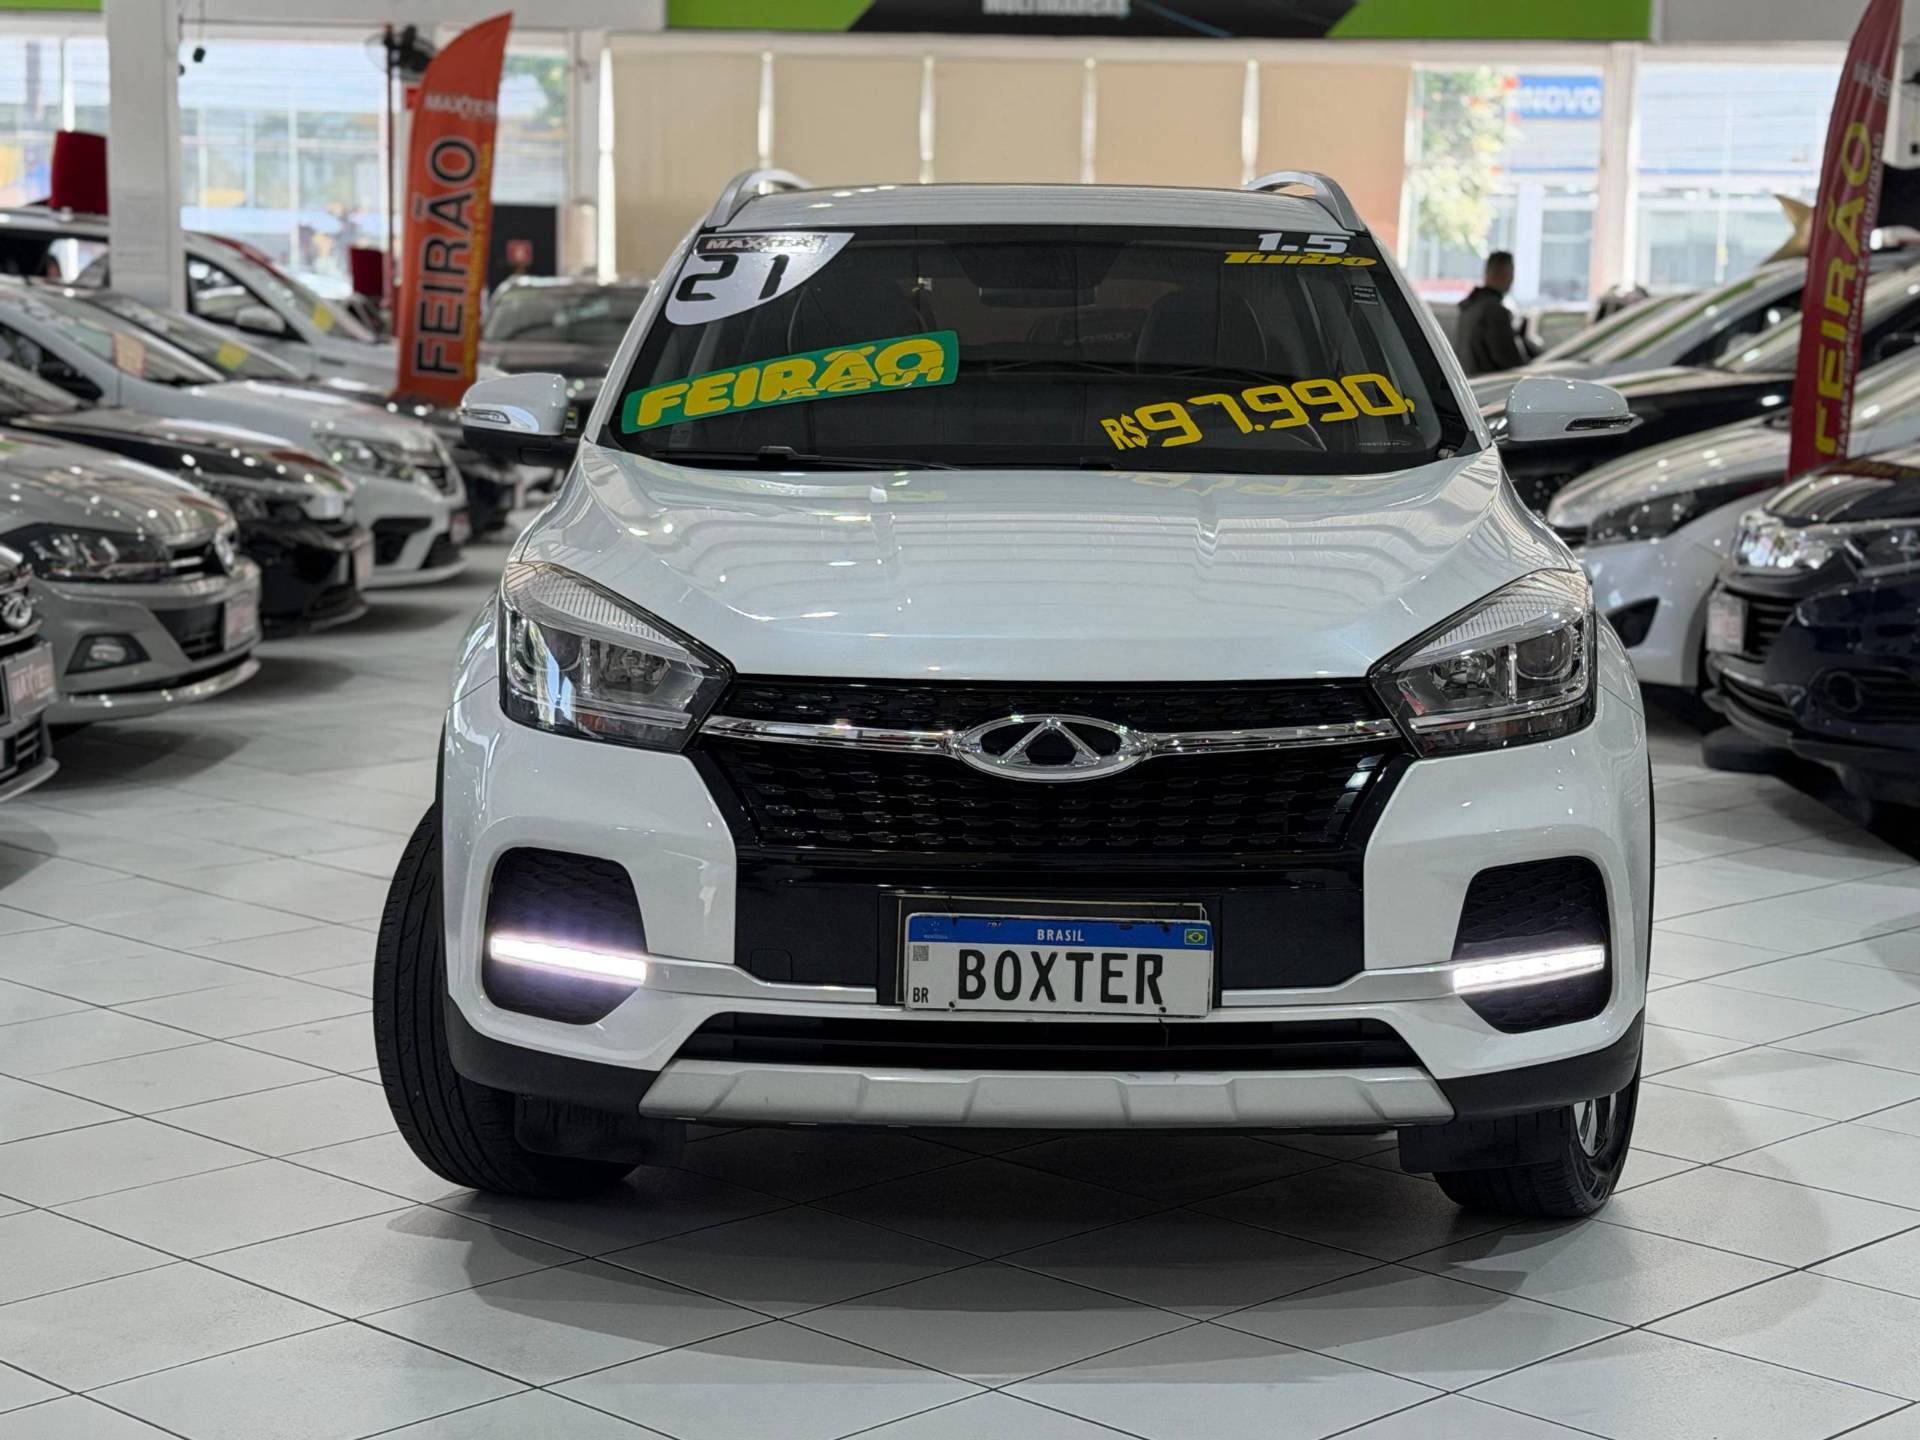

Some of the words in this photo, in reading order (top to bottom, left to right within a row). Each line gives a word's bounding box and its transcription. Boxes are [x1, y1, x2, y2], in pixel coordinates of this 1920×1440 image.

[412, 135, 479, 379] FEIRÃO
[1258, 232, 1351, 254] 1.5
[675, 254, 790, 302] 21
[1815, 121, 1872, 456] FEIRÃO
[637, 338, 945, 426] FEIRÃO
[1036, 928, 1085, 942] BRASIL
[912, 987, 929, 1003] BR
[958, 949, 1163, 1004] BOXTER
